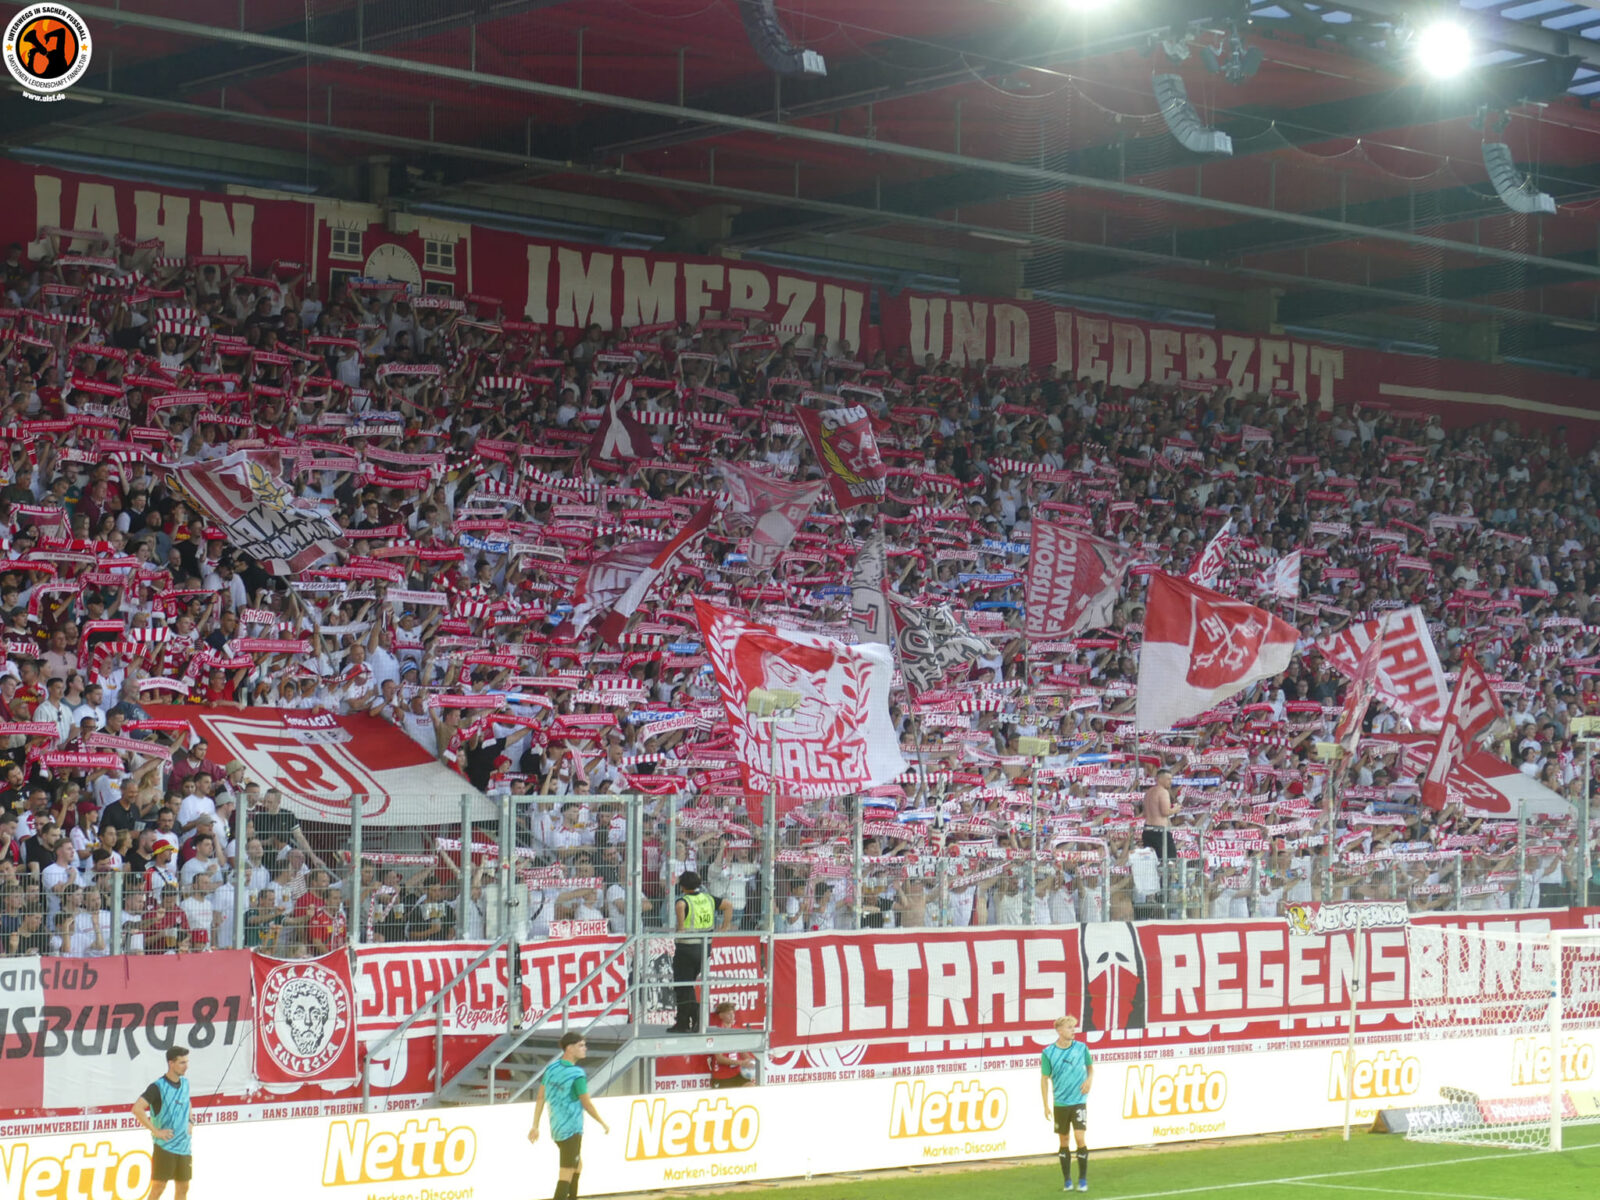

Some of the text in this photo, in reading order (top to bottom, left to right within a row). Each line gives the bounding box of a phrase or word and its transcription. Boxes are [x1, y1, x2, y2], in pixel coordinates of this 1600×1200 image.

[28, 175, 1344, 412] JAHN IMMERZU UND JEDERZEIT
[1028, 522, 1055, 632] RATISBONA
[558, 669, 588, 678] JAHNELF
[47, 754, 65, 763] ALLES
[1037, 764, 1100, 779] AHN STADION
[577, 920, 607, 936] JAHRE
[710, 945, 757, 966] KTION
[361, 950, 627, 1017] JAHNGSTERS
[794, 937, 1067, 1037] ULTRAS
[1157, 918, 1551, 1015] REGENSBURG
[188, 994, 242, 1050] 81
[1354, 1035, 1365, 1045] AHN
[1100, 1050, 1142, 1063] REGENSBURG
[1143, 1049, 1158, 1061] SEIT
[1189, 1046, 1206, 1057] HANS
[1207, 1044, 1226, 1056] JAKOB
[892, 1062, 968, 1078] HANS JAKOB TRIBÜNE
[984, 1060, 1009, 1071] SPORT-
[1010, 1058, 1024, 1069] UND
[767, 1068, 876, 1085] JAHN REGENSBURG SEIT 1889
[1328, 1050, 1421, 1101] Netto
[655, 1080, 680, 1091] PORT-
[681, 1079, 697, 1090] UND
[1122, 1064, 1228, 1120] Netto
[262, 1101, 365, 1119] HANS JAKOB TRIBÜNE
[386, 1098, 420, 1111] SPORT-
[888, 1080, 1009, 1140] Netto
[92, 1116, 118, 1131] JAHN
[215, 1110, 239, 1123] 1889
[625, 1097, 760, 1162] Netto
[1152, 1121, 1226, 1137] Marken-Discount
[322, 1118, 477, 1187] Netto
[922, 1140, 1007, 1158] Marken-Discount
[0, 1141, 153, 1200] Netto
[663, 1162, 757, 1181] Marken-Discount
